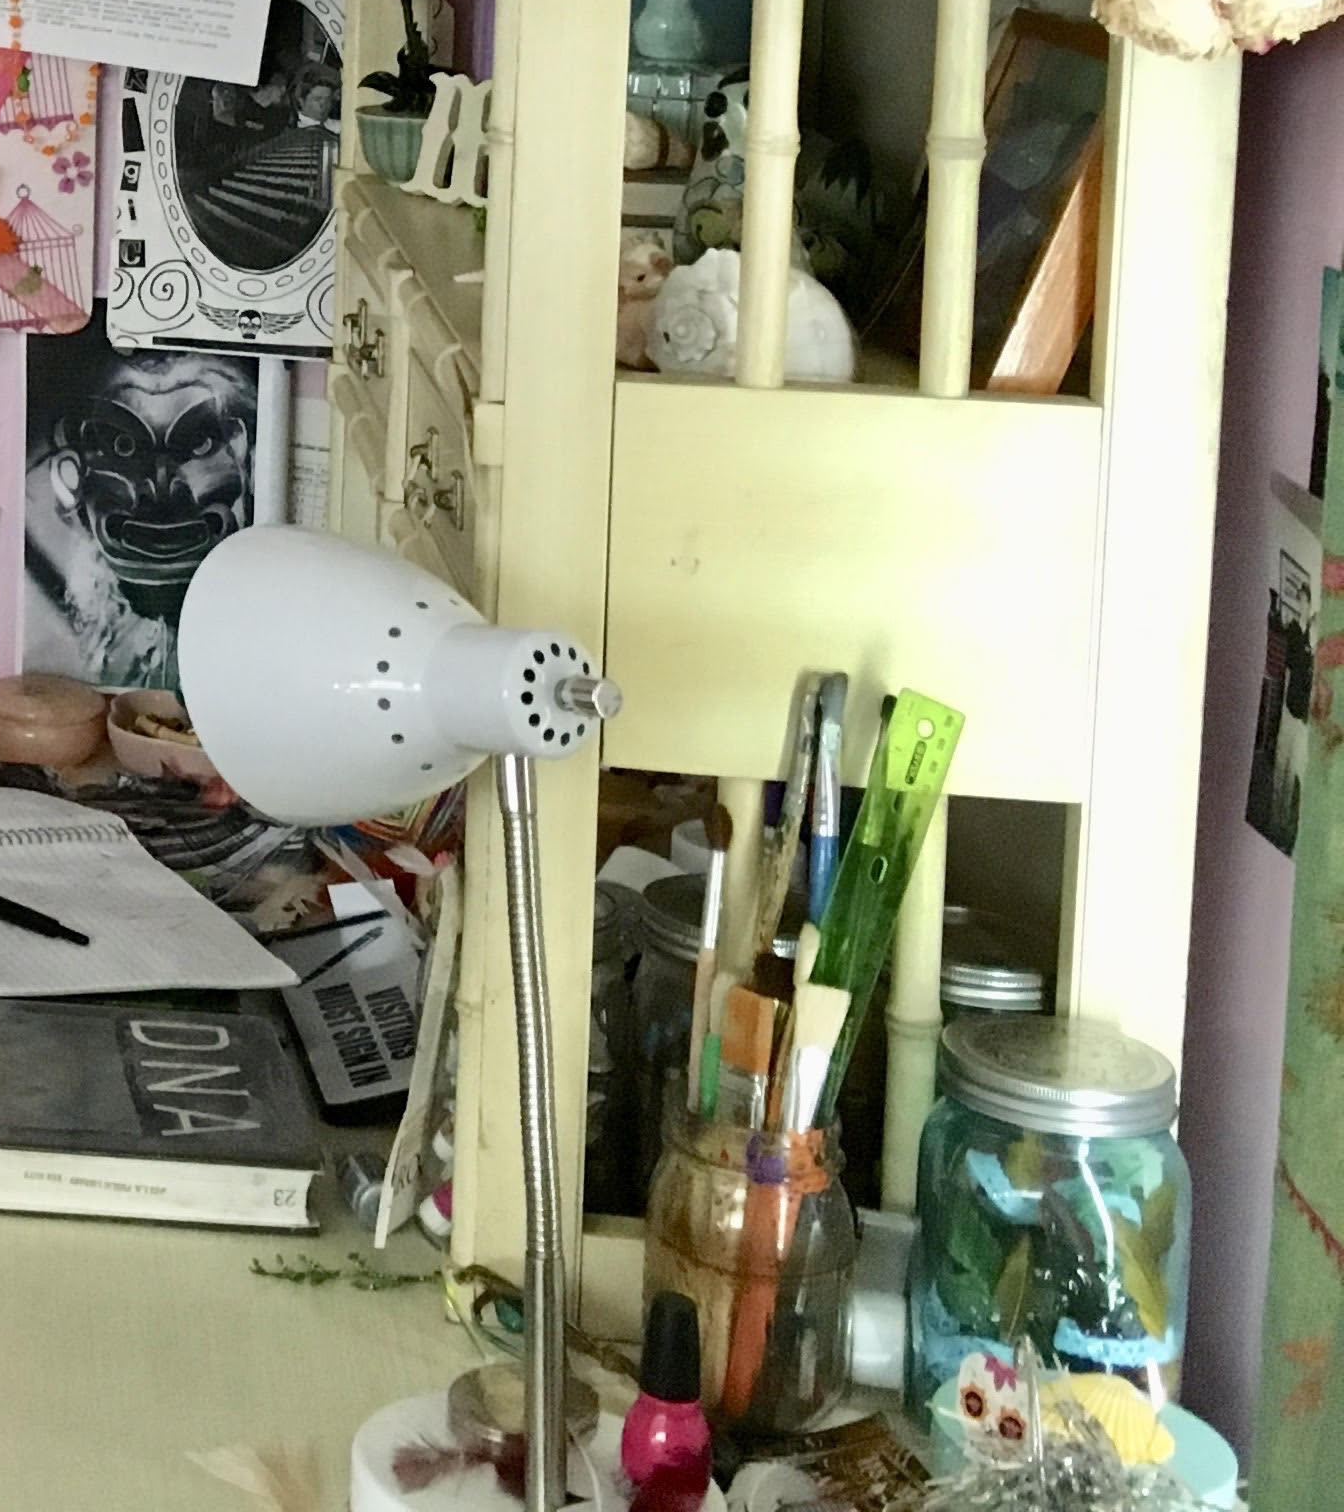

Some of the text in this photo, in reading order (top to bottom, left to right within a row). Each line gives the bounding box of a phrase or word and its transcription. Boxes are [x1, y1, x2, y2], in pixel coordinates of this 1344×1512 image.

[313, 982, 393, 1089] MUST SIGN IN
[364, 986, 417, 1062] VISITORS
[128, 1019, 262, 1137] DNA
[273, 1189, 297, 1208] 23
